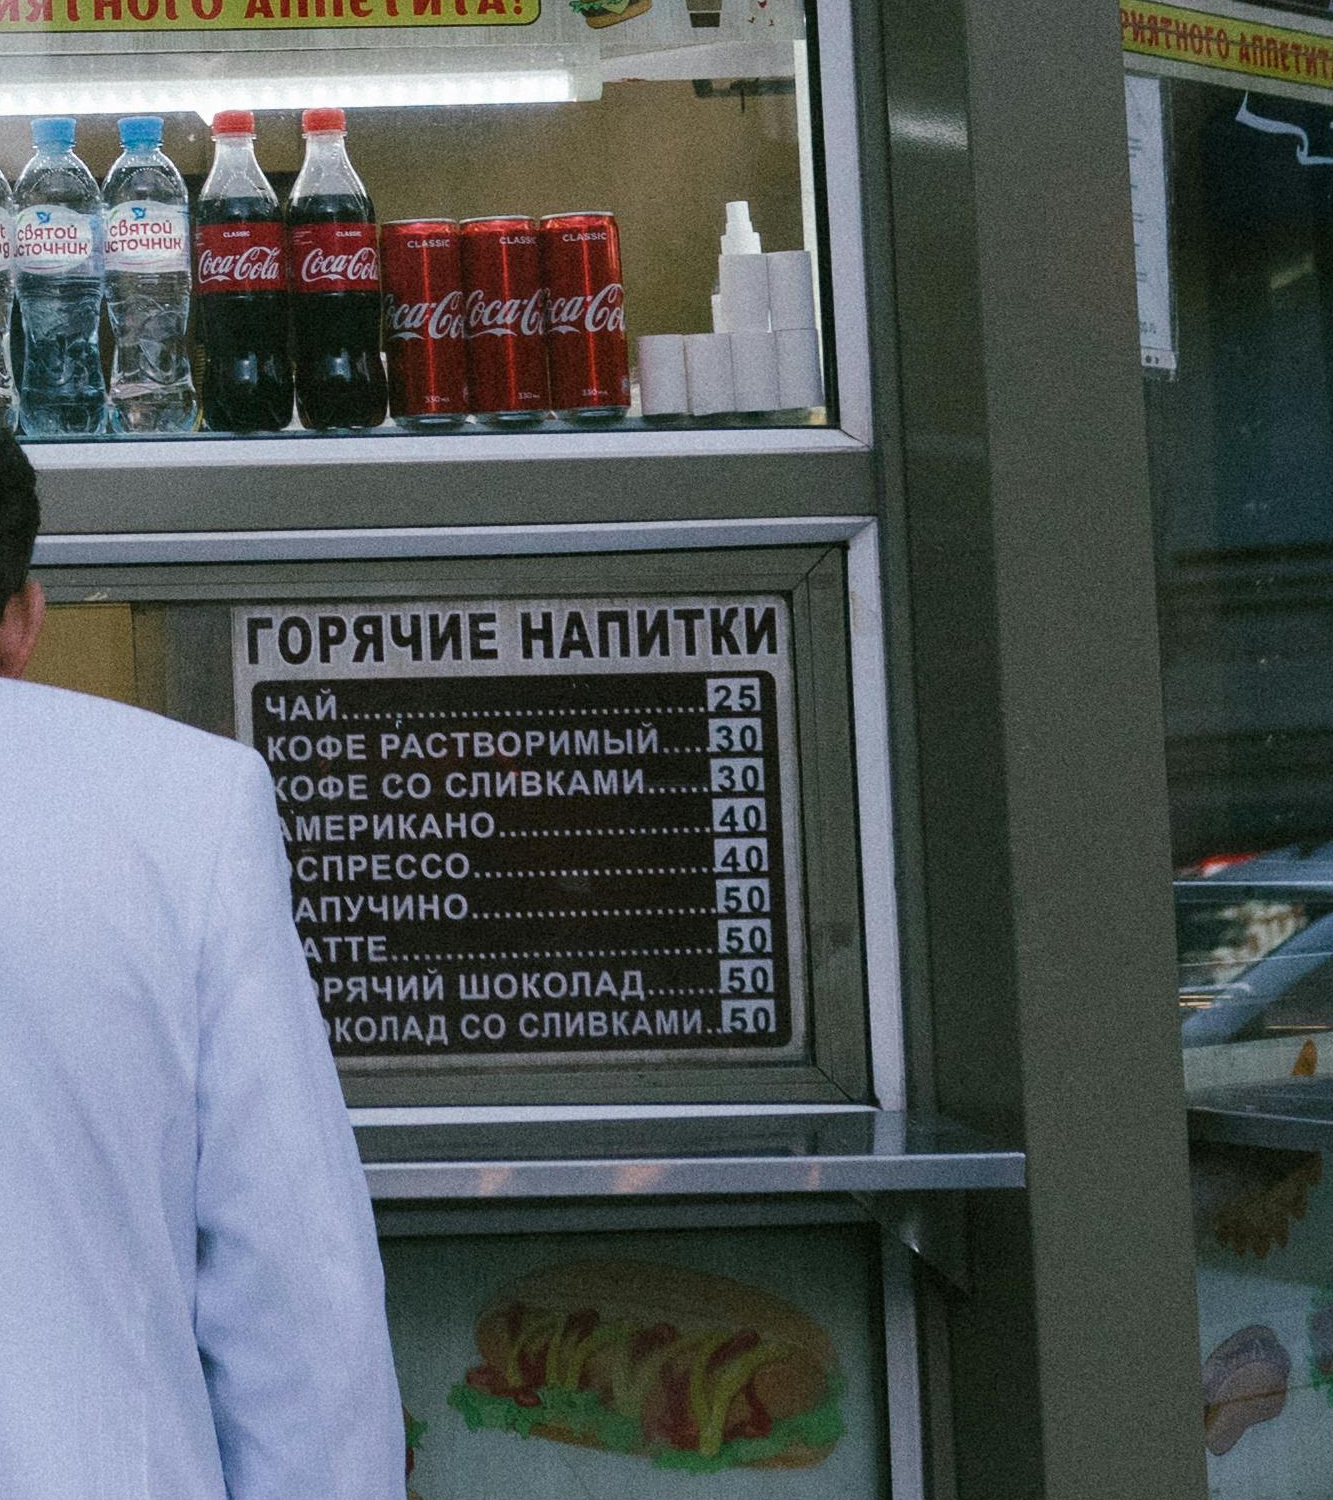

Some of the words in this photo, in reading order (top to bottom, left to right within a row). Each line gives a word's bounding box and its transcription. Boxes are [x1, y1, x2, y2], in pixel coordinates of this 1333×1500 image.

[407, 239, 450, 248] CLASSIC
[563, 233, 607, 242] CLASSIC
[246, 613, 498, 665] ГОРЯЧИЕ
[522, 607, 778, 660] НАПИТКИ
[265, 687, 336, 721] ЧАЙ
[714, 686, 756, 711] 25
[267, 734, 367, 761] КОФЕ
[380, 721, 658, 758] РАСТВОРИМЫЙ
[715, 726, 758, 751] 30
[381, 773, 431, 799] СО
[445, 769, 645, 797] СЛИВКАМИ
[717, 766, 759, 791] 30
[719, 806, 761, 831] 40
[284, 853, 469, 882] СПРЕССО
[721, 846, 763, 872] 40
[294, 893, 468, 922] АПУЧИНО
[723, 886, 764, 912] 50
[301, 936, 386, 962] АТТЕ
[725, 927, 766, 952] 50
[312, 968, 443, 1003] РЯЧИЙ
[459, 970, 643, 1005] ШОКОЛАД
[726, 967, 768, 993] 50
[324, 1015, 447, 1048] КОЛАД
[461, 1014, 505, 1039] СО
[519, 1009, 702, 1038] СЛИВКАМИ
[728, 1007, 770, 1032] 50
